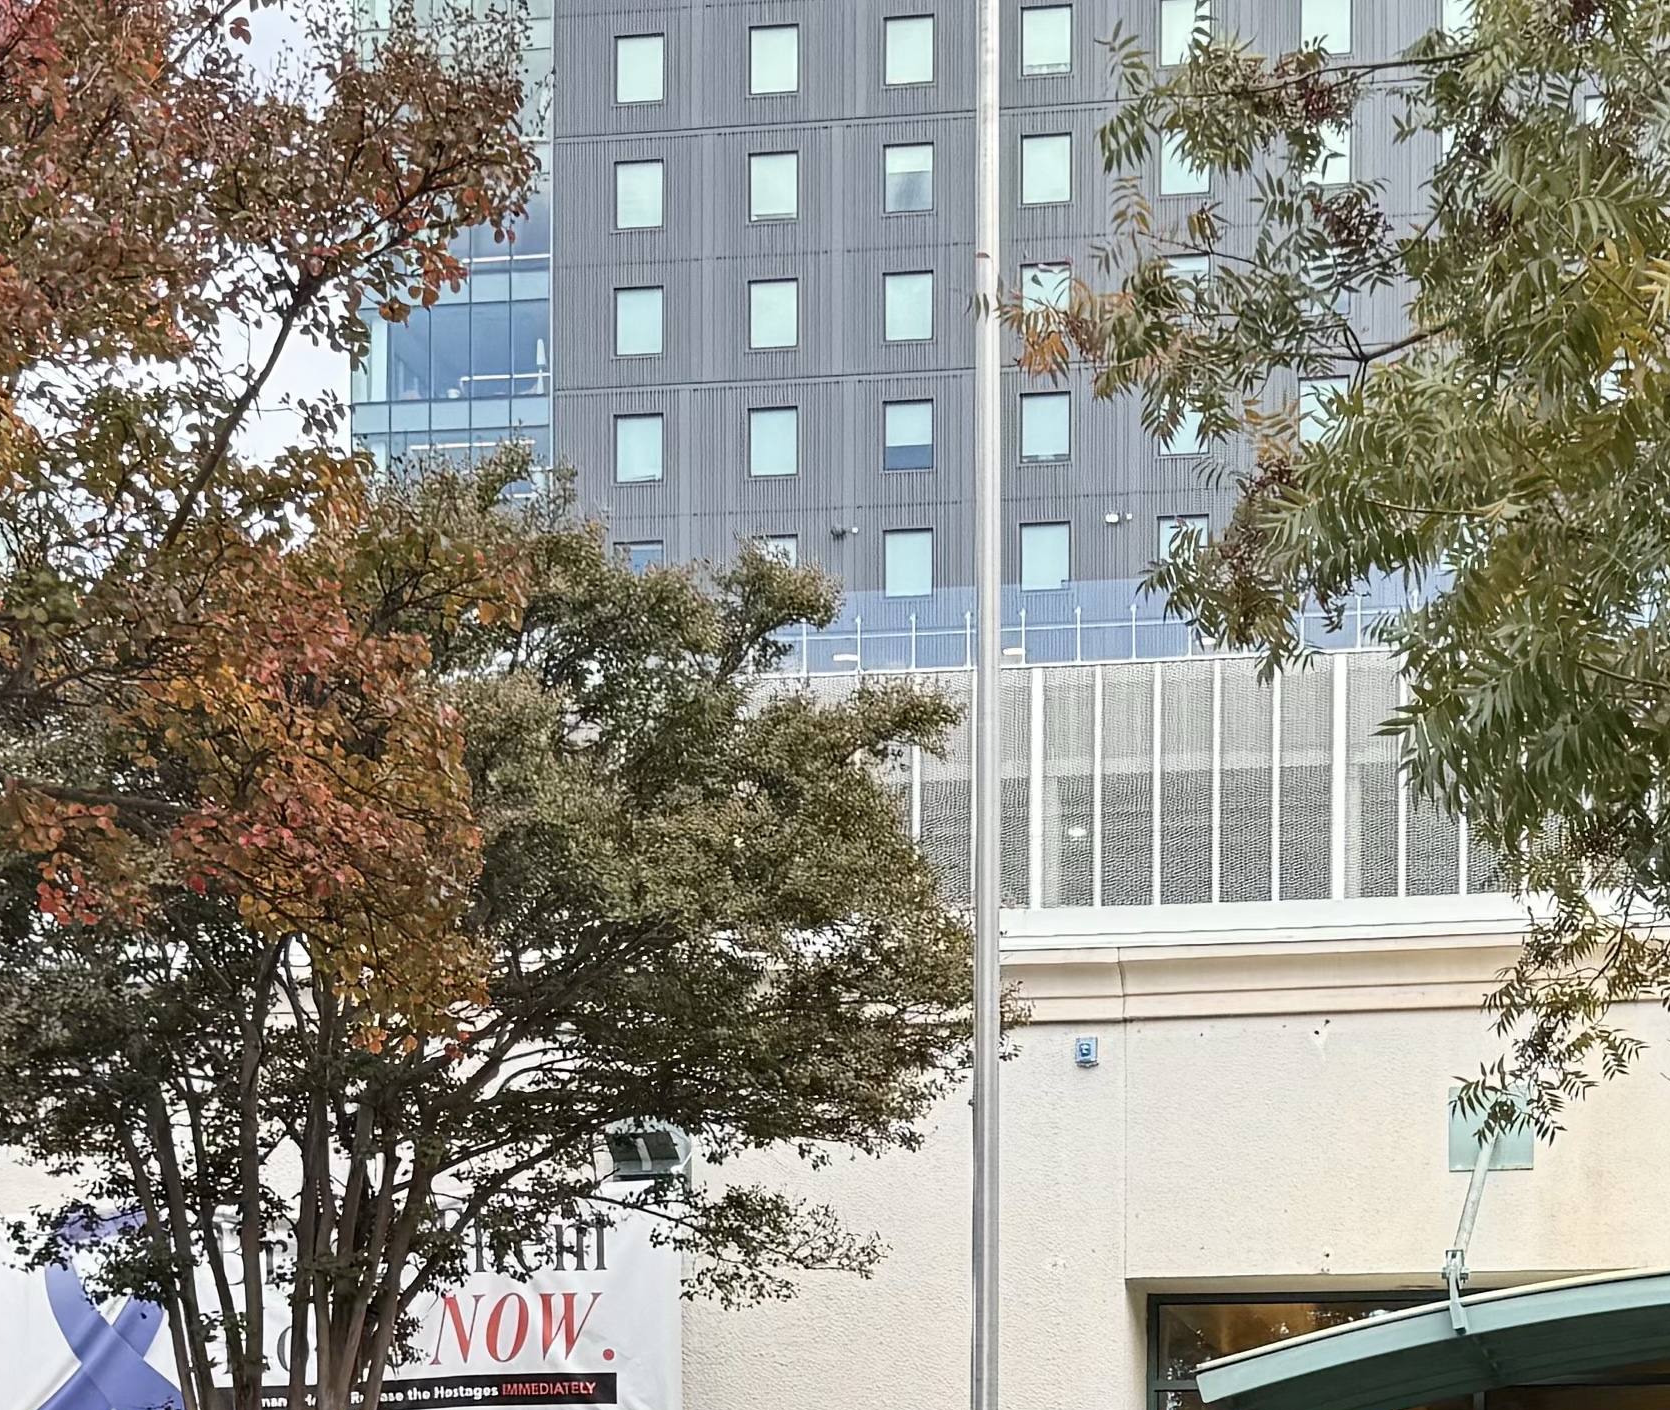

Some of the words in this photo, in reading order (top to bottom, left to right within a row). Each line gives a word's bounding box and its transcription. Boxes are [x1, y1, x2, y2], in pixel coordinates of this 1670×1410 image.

[431, 1292, 615, 1365] NOW.
[407, 1386, 430, 1401] the
[434, 1384, 499, 1400] Hostages
[502, 1382, 596, 1396] IMMEDIATELY
